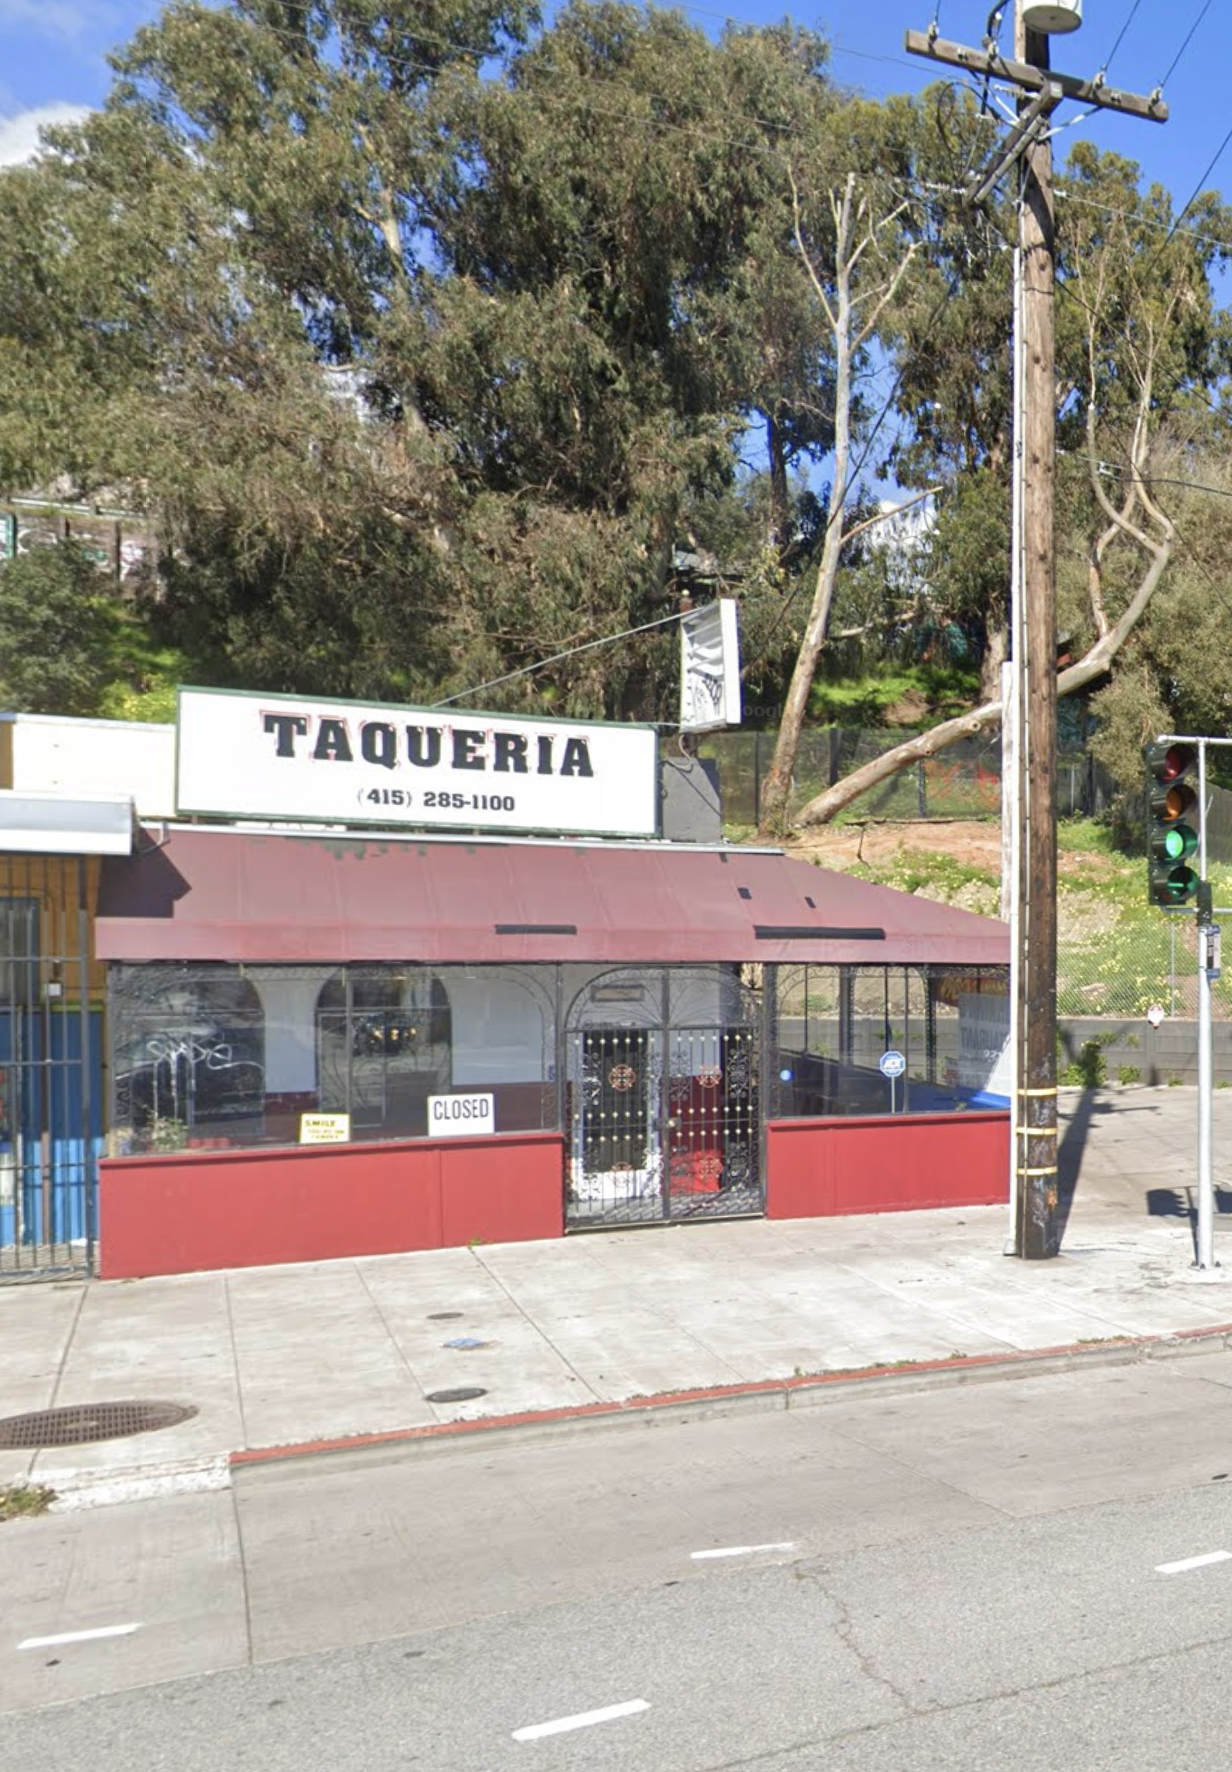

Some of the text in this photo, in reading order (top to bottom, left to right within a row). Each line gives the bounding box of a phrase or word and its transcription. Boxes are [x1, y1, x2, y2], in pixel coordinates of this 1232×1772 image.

[262, 712, 594, 778] TAQUERIA
[357, 788, 516, 811] (415) 285-1100
[434, 1098, 489, 1120] CLOSED
